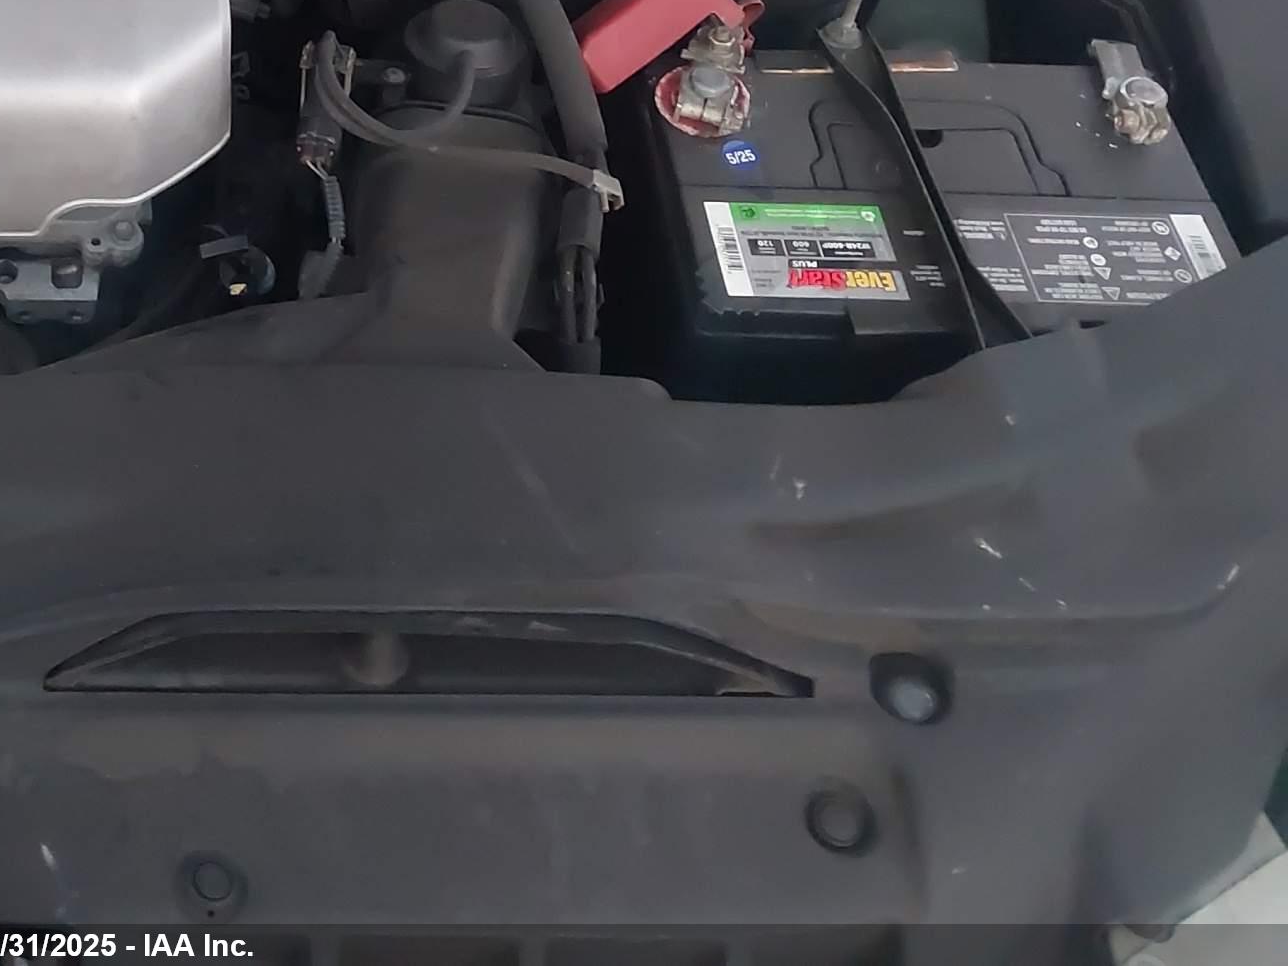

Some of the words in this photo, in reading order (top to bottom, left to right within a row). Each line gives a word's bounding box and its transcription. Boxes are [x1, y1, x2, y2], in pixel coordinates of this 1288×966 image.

[725, 149, 756, 165] 5/25
[756, 239, 774, 248] 120
[791, 260, 818, 269] PLUS
[788, 268, 897, 291] EverStart
